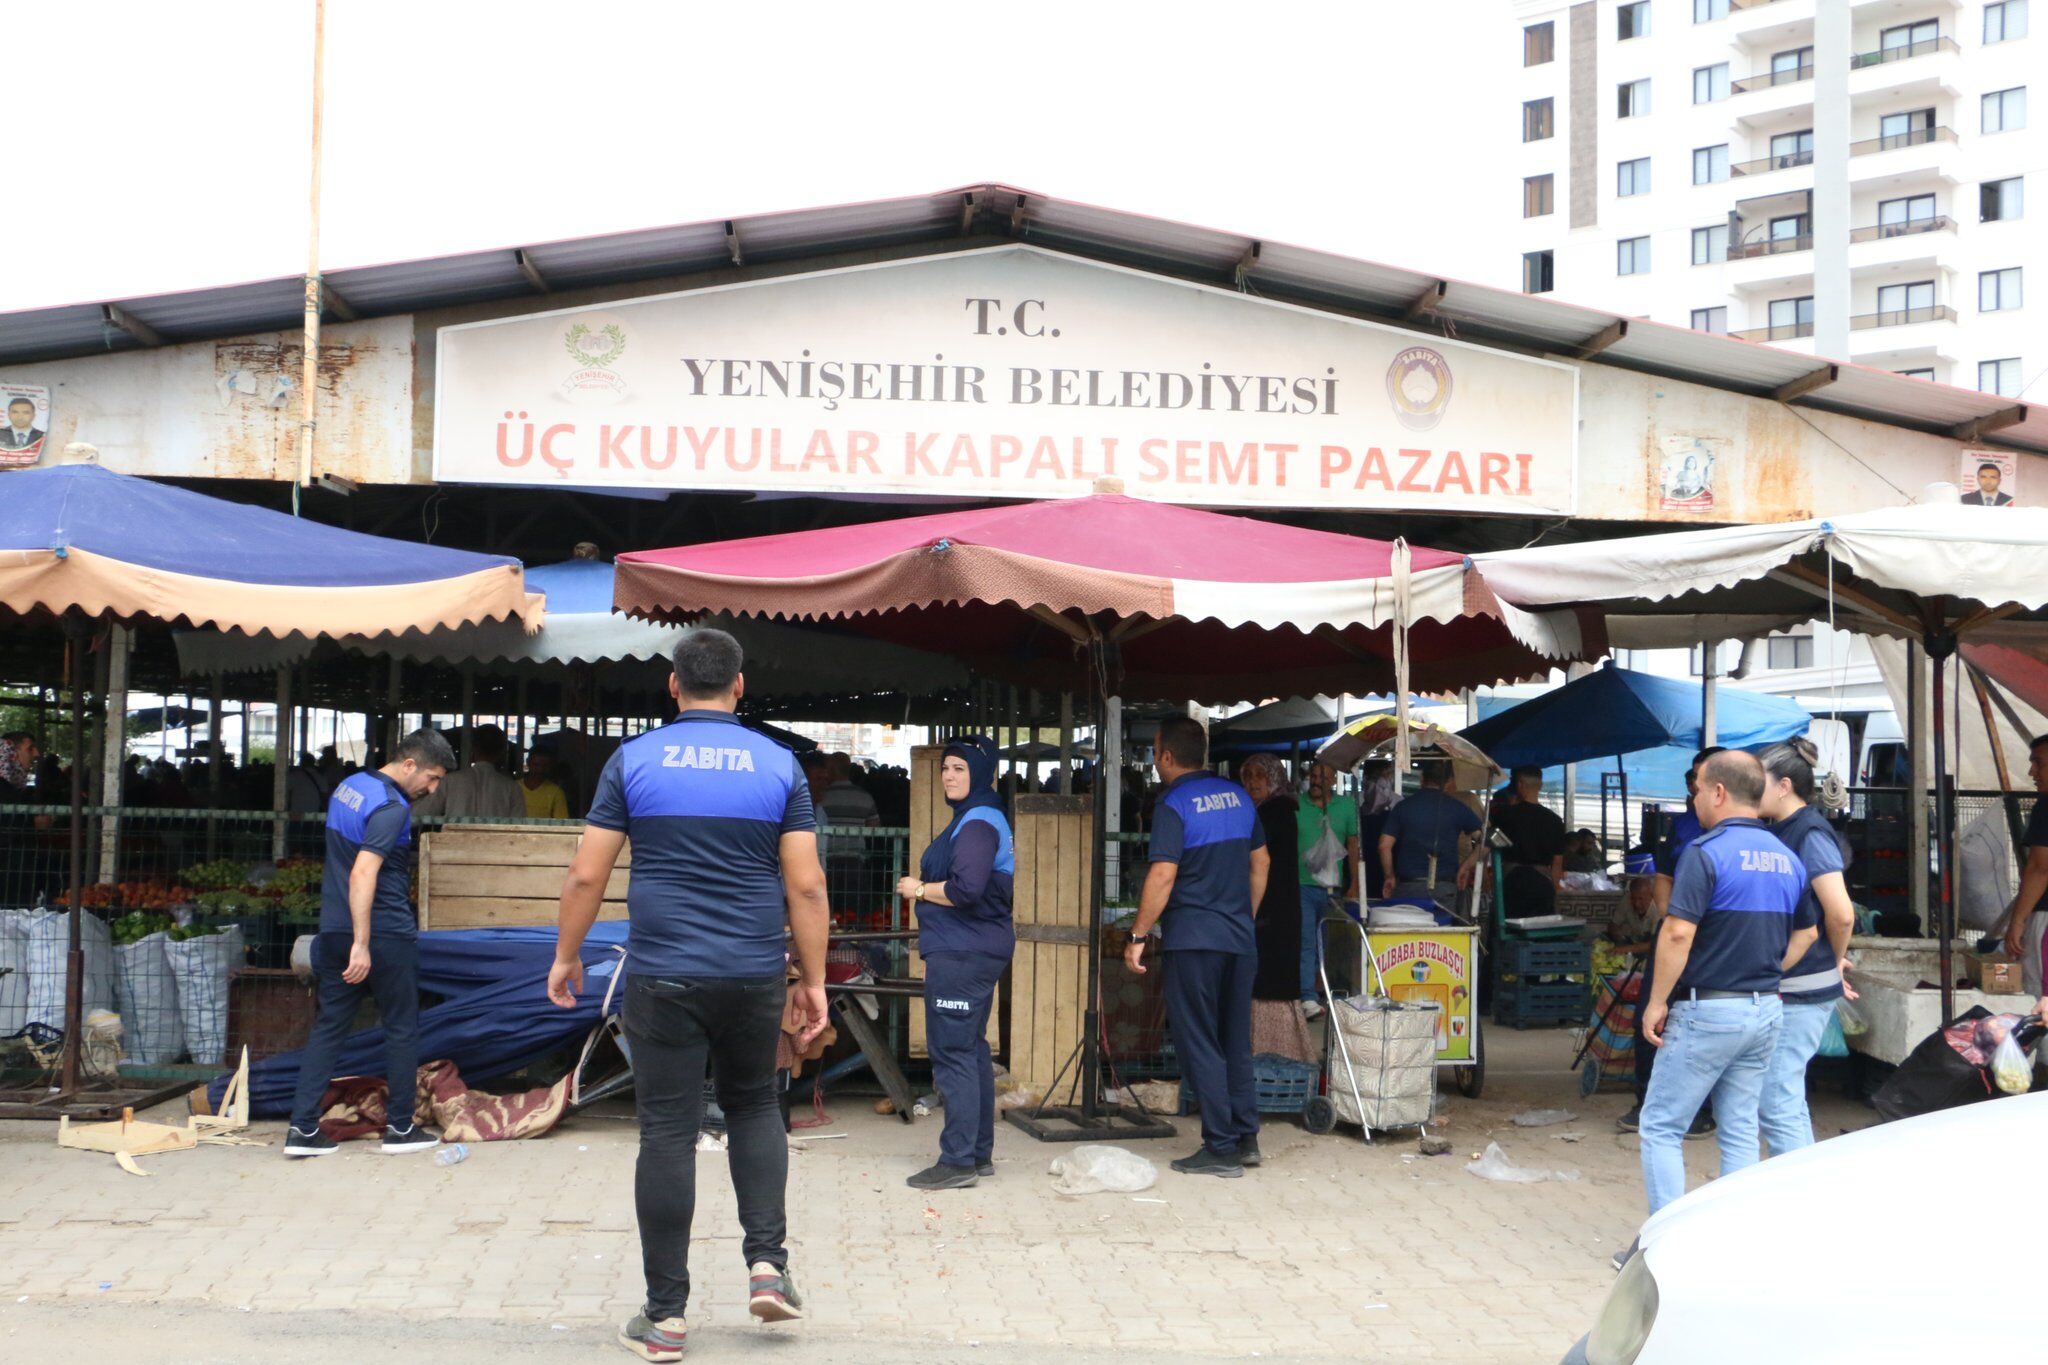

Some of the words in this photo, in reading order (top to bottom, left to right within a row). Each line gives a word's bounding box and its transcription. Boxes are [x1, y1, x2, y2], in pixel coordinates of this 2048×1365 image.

[966, 298, 1061, 338] T.C.
[1401, 351, 1439, 367] ZABITA
[680, 349, 988, 411] YENİŞEHİR
[1008, 362, 1341, 416] BELEDİYESİ
[495, 410, 577, 479] ÜÇ
[600, 424, 880, 475] KUYULAR
[905, 431, 1120, 481] KAPALI
[1138, 438, 1299, 488] SEMT
[1319, 444, 1534, 497] PAZARI
[661, 745, 755, 772] ZABITA
[1191, 791, 1242, 814] ZABITA
[1739, 850, 1793, 876] ZABITA
[1418, 940, 1465, 979] BUZLAŞÇI
[935, 998, 970, 1011] ZABITA
